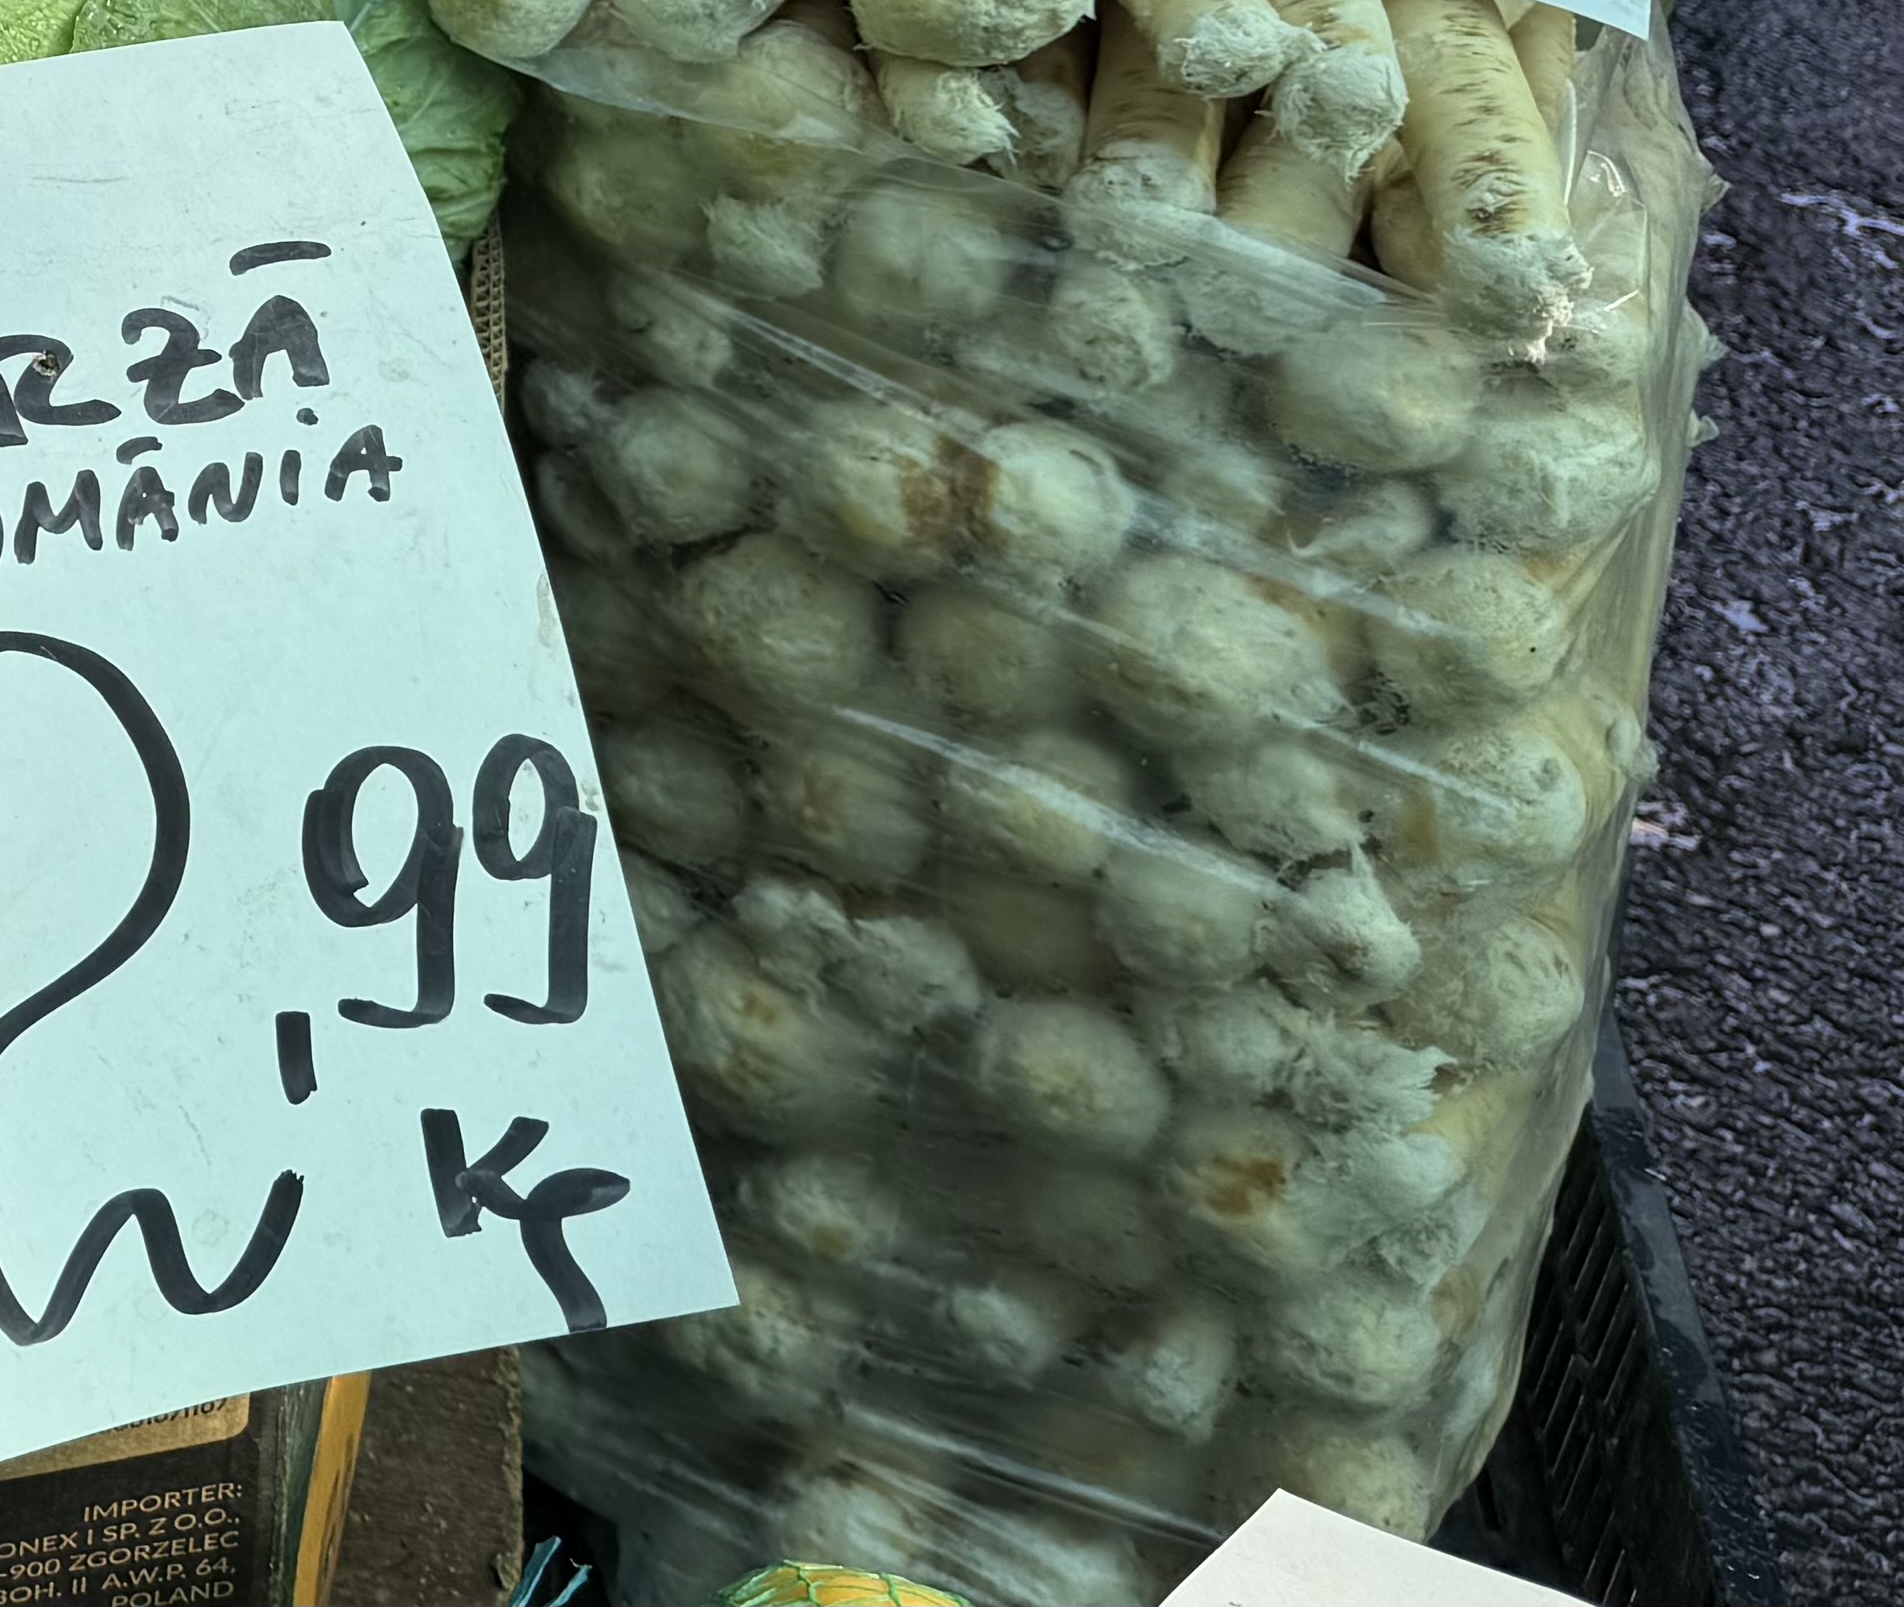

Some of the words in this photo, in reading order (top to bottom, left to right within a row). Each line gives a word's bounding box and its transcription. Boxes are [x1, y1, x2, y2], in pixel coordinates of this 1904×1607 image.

[83, 1482, 243, 1523] IMPORTER:
[102, 1523, 141, 1543] SP.
[148, 1517, 167, 1535] Z
[68, 1530, 240, 1573] ZGORZELEC
[71, 1576, 88, 1596] II
[101, 1565, 187, 1591] A.W.P.
[111, 1580, 235, 1607] POLAND
